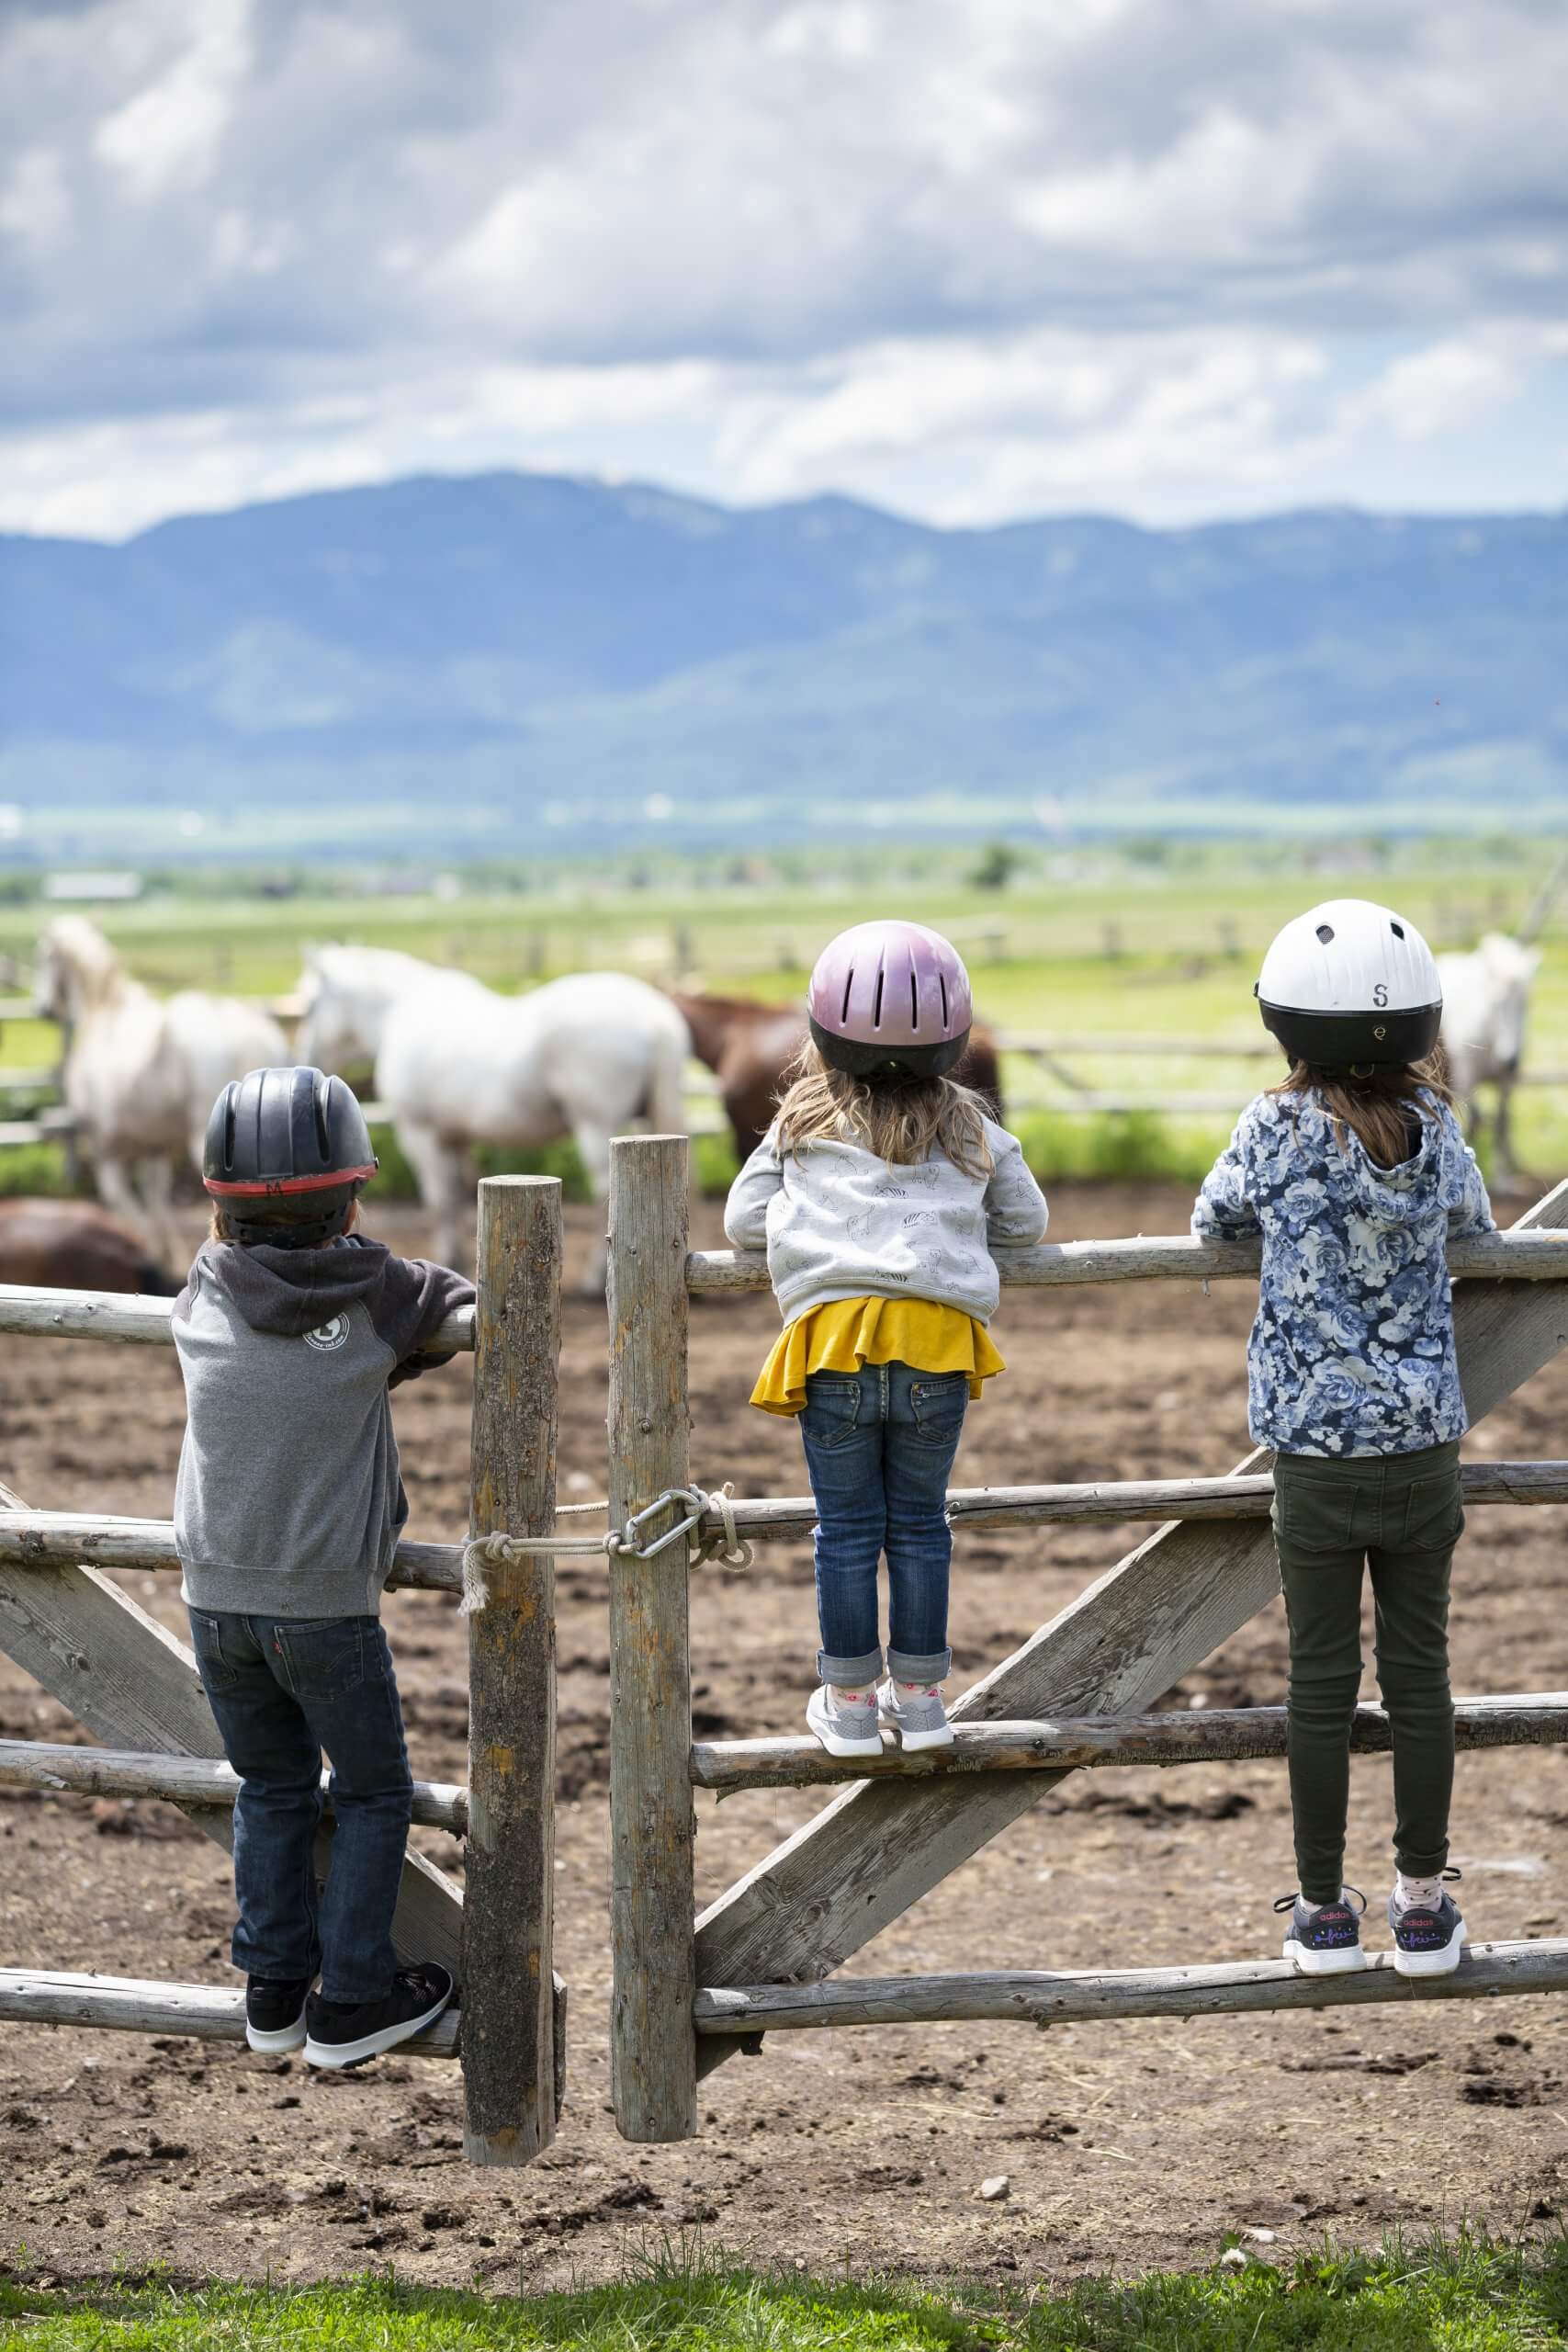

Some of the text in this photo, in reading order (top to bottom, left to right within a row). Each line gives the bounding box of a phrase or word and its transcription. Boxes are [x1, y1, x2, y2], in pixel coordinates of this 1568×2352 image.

[1372, 983, 1388, 1008] S
[1319, 1911, 1350, 1921] adidas
[1404, 1918, 1434, 1927] adidas
